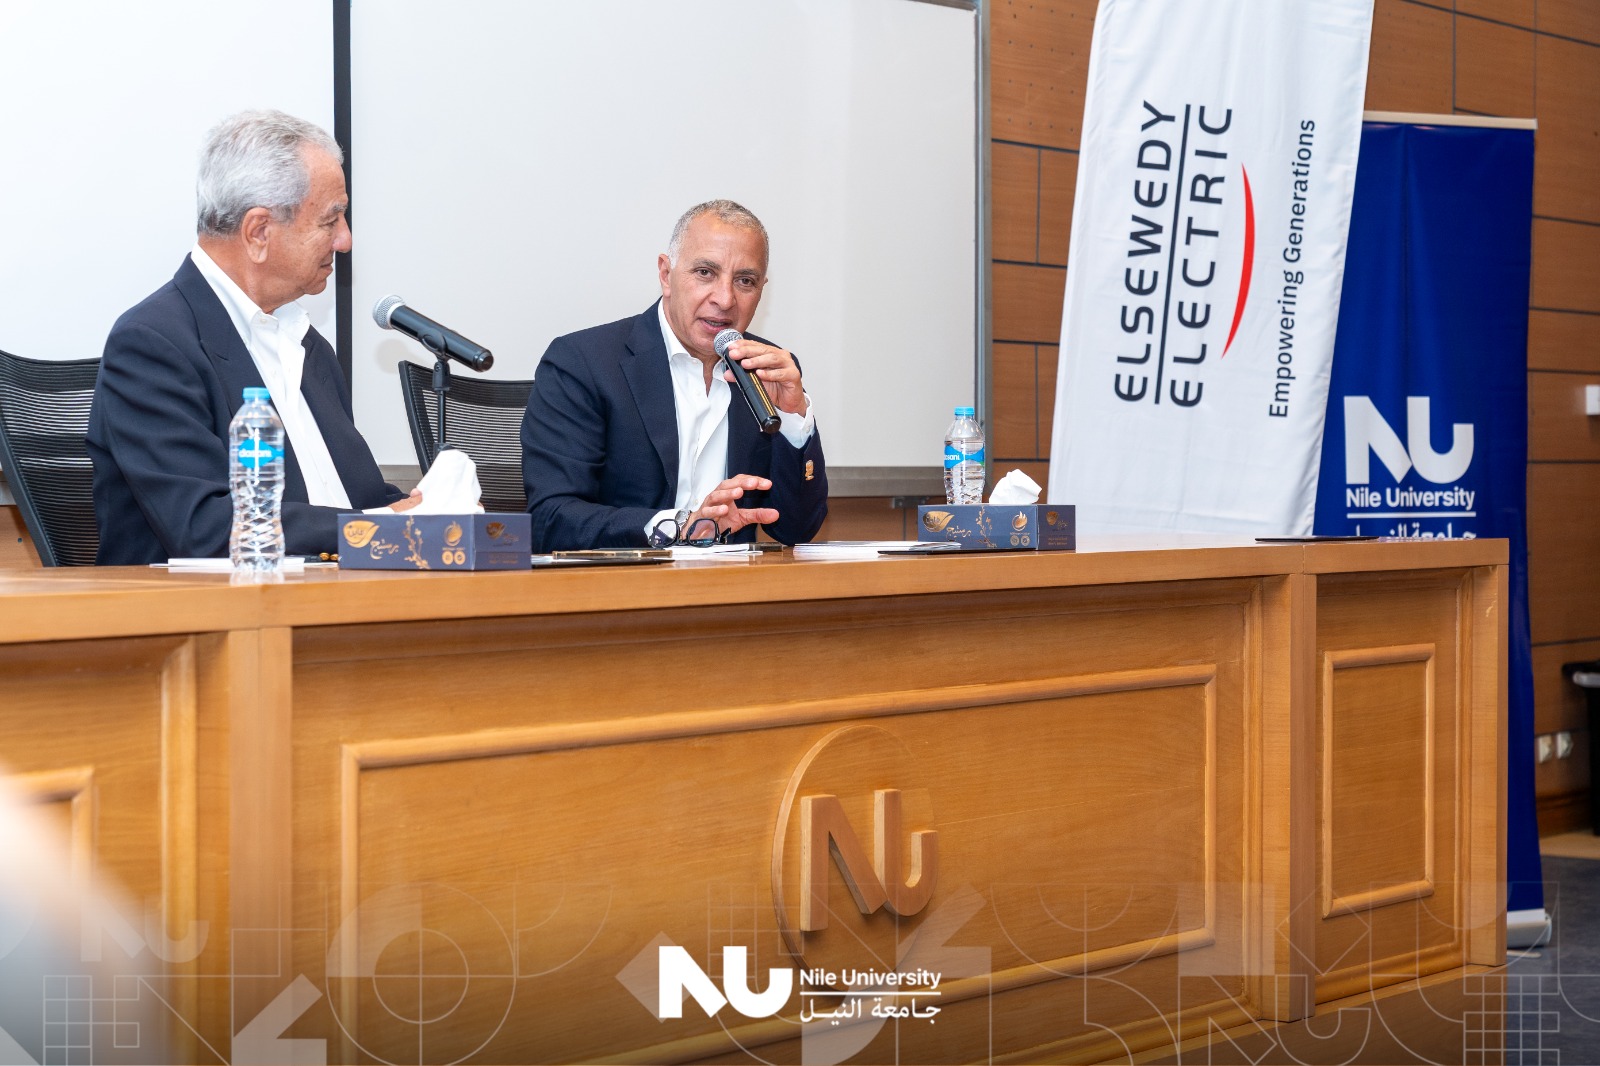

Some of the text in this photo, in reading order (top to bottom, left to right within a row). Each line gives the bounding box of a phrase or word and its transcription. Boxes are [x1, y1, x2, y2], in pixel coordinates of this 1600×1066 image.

[1113, 100, 1176, 402] ELSEWEDY
[1170, 105, 1232, 407] ELECTRIC
[1269, 119, 1315, 418] Empowering Generations
[1344, 396, 1474, 484] NU
[1346, 486, 1475, 510] Nile University
[801, 788, 938, 931] NU
